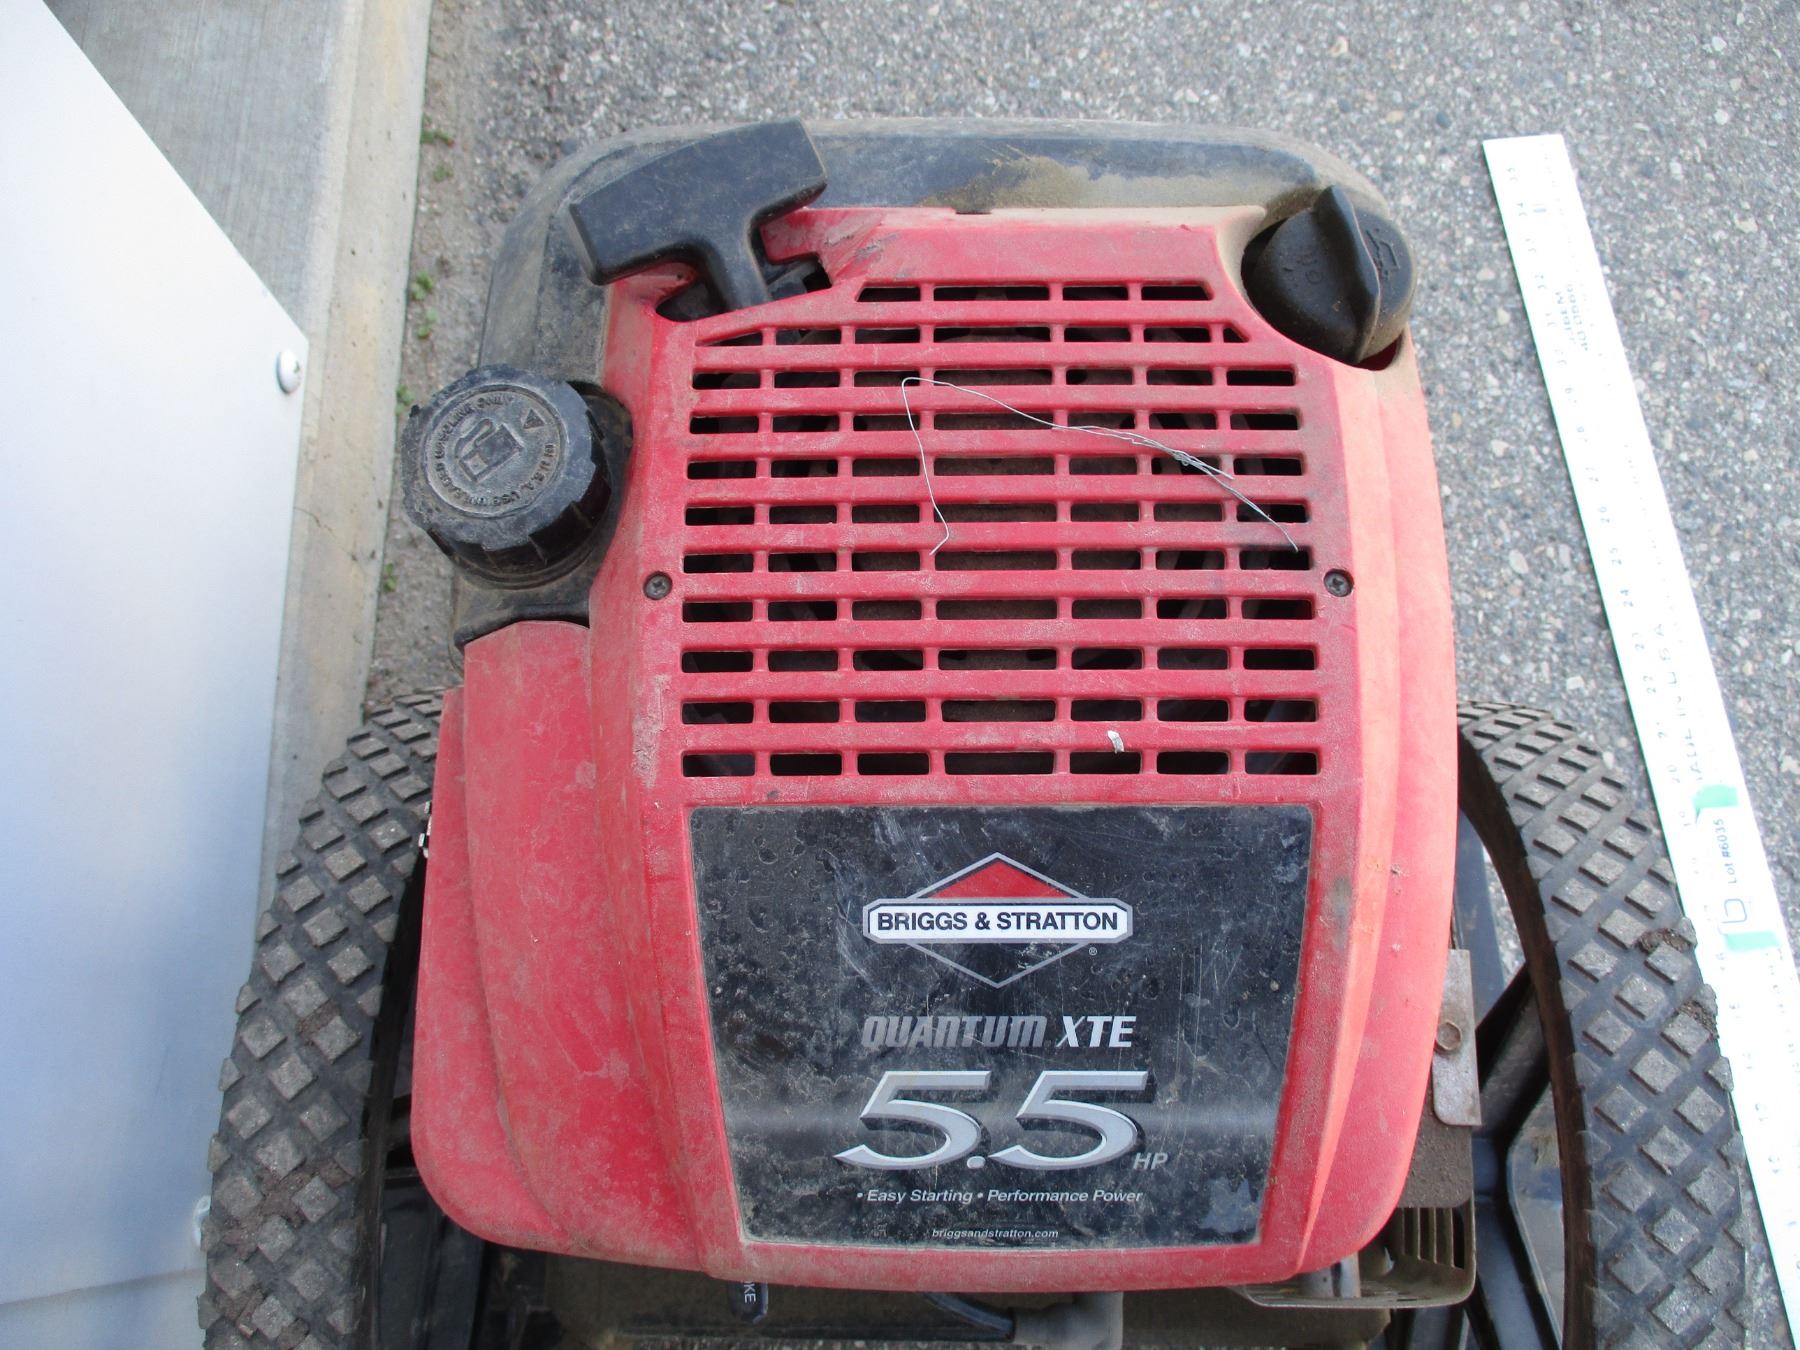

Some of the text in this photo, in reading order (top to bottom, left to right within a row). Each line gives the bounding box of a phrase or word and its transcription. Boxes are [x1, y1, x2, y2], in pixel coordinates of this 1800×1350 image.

[1712, 818, 1732, 858] #6035
[877, 911, 1118, 931] BRIGGS & STRATTON
[861, 1015, 1137, 1049] QUANTUM XTE
[833, 1070, 1169, 1171] 5.5 HP
[867, 1189, 1144, 1205] Easy Starting Performance Power
[931, 1228, 1059, 1240] briggsandstratton.com
